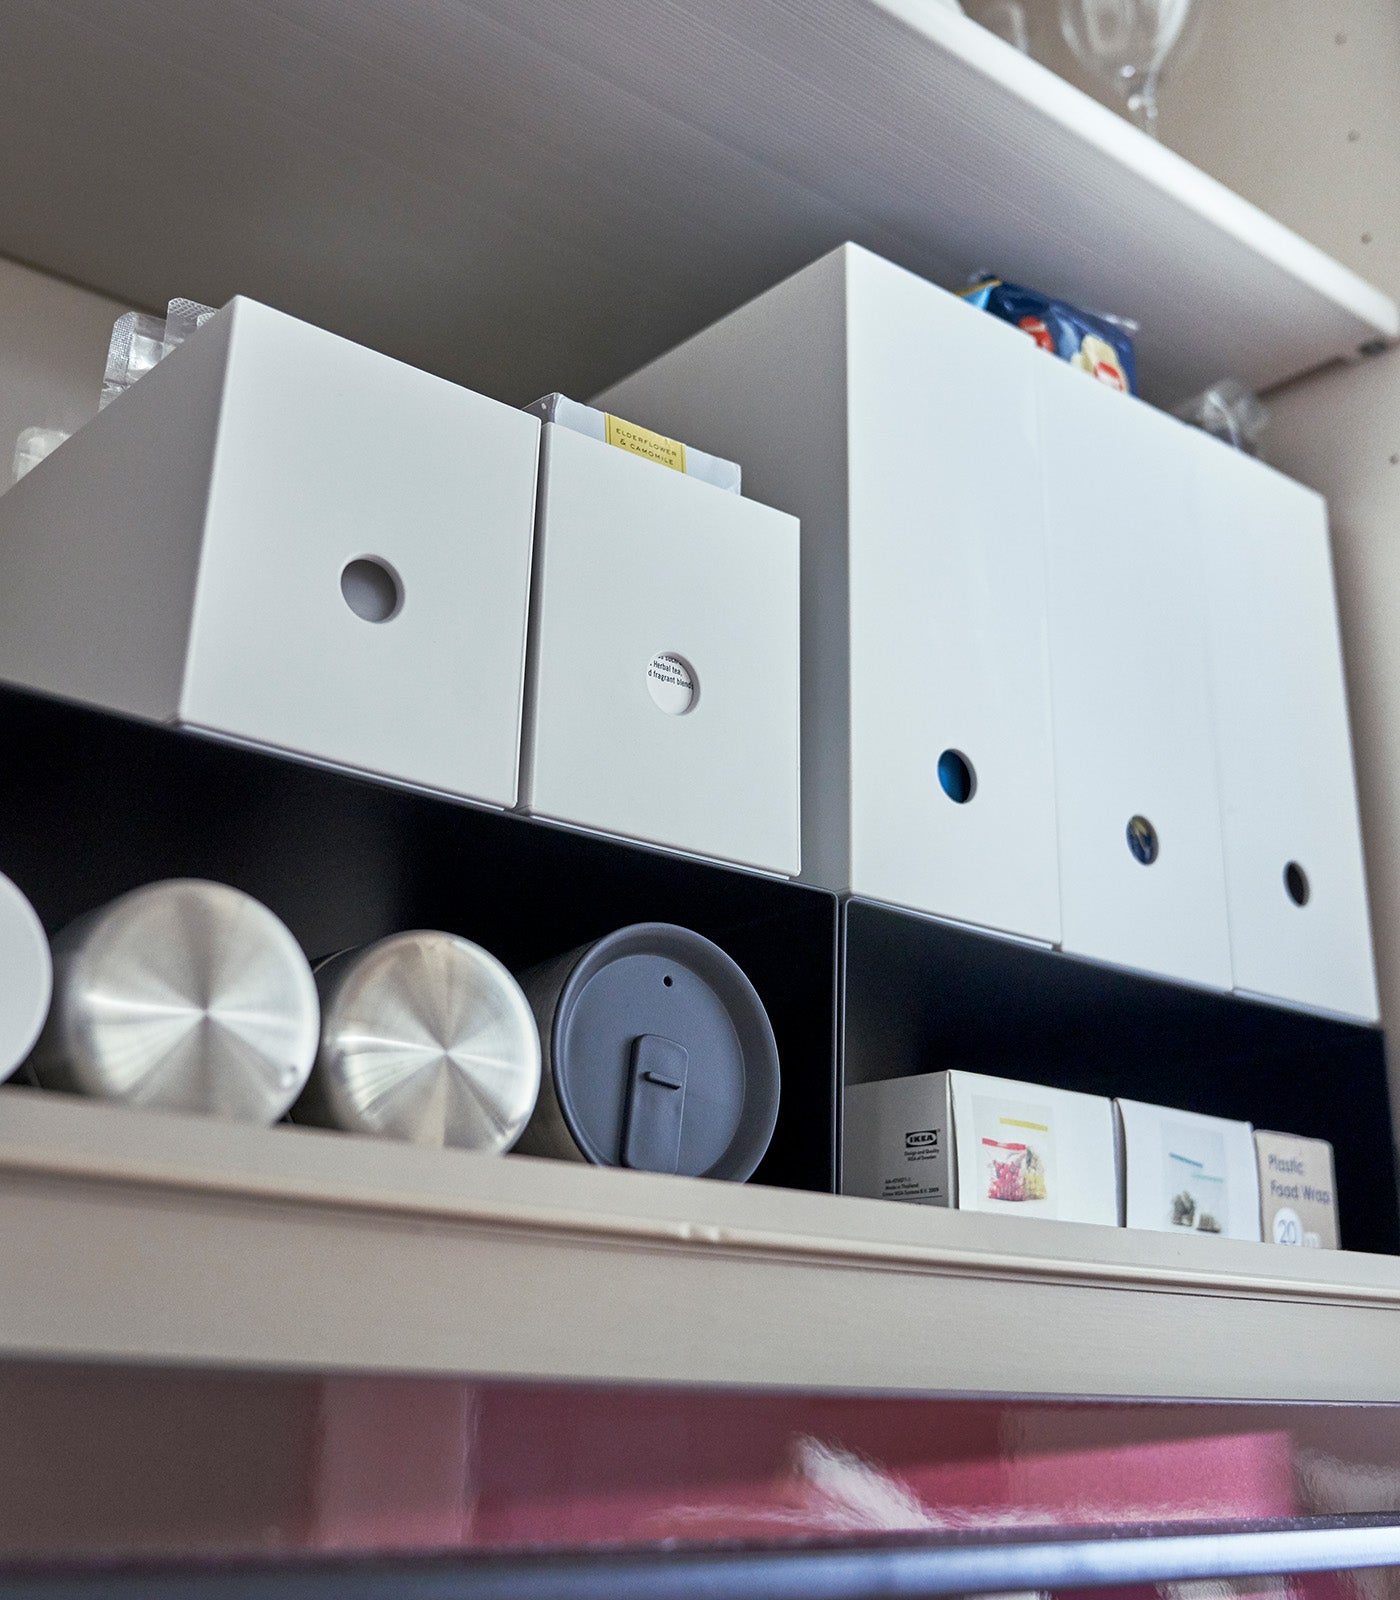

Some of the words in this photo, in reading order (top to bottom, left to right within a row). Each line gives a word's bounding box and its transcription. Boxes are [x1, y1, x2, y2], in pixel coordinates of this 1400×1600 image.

[616, 428, 677, 456] ELDERFLOWER
[630, 444, 674, 466] CAMOMILE
[654, 660, 671, 672] Herbal
[653, 671, 676, 684] fragrant
[910, 1134, 933, 1143] IKEA
[1268, 1154, 1304, 1176] Plastic
[1270, 1180, 1299, 1200] Food
[1303, 1186, 1330, 1205] Wrap
[1278, 1219, 1296, 1244] 20
